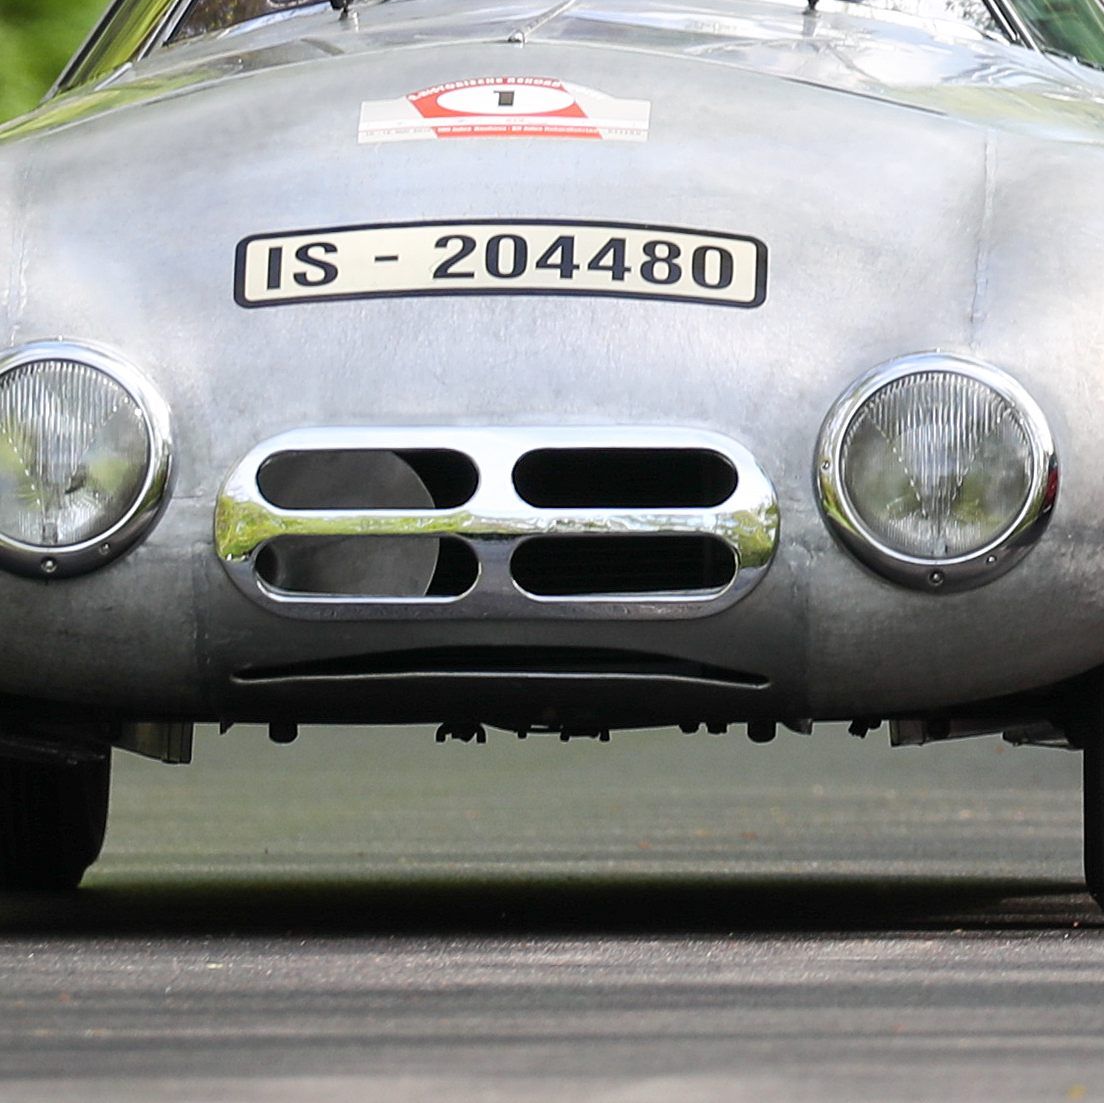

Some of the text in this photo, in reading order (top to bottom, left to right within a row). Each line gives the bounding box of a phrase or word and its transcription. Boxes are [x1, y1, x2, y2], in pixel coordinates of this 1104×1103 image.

[493, 90, 515, 107] 1
[266, 242, 339, 290] IS
[432, 234, 734, 290] 204480
